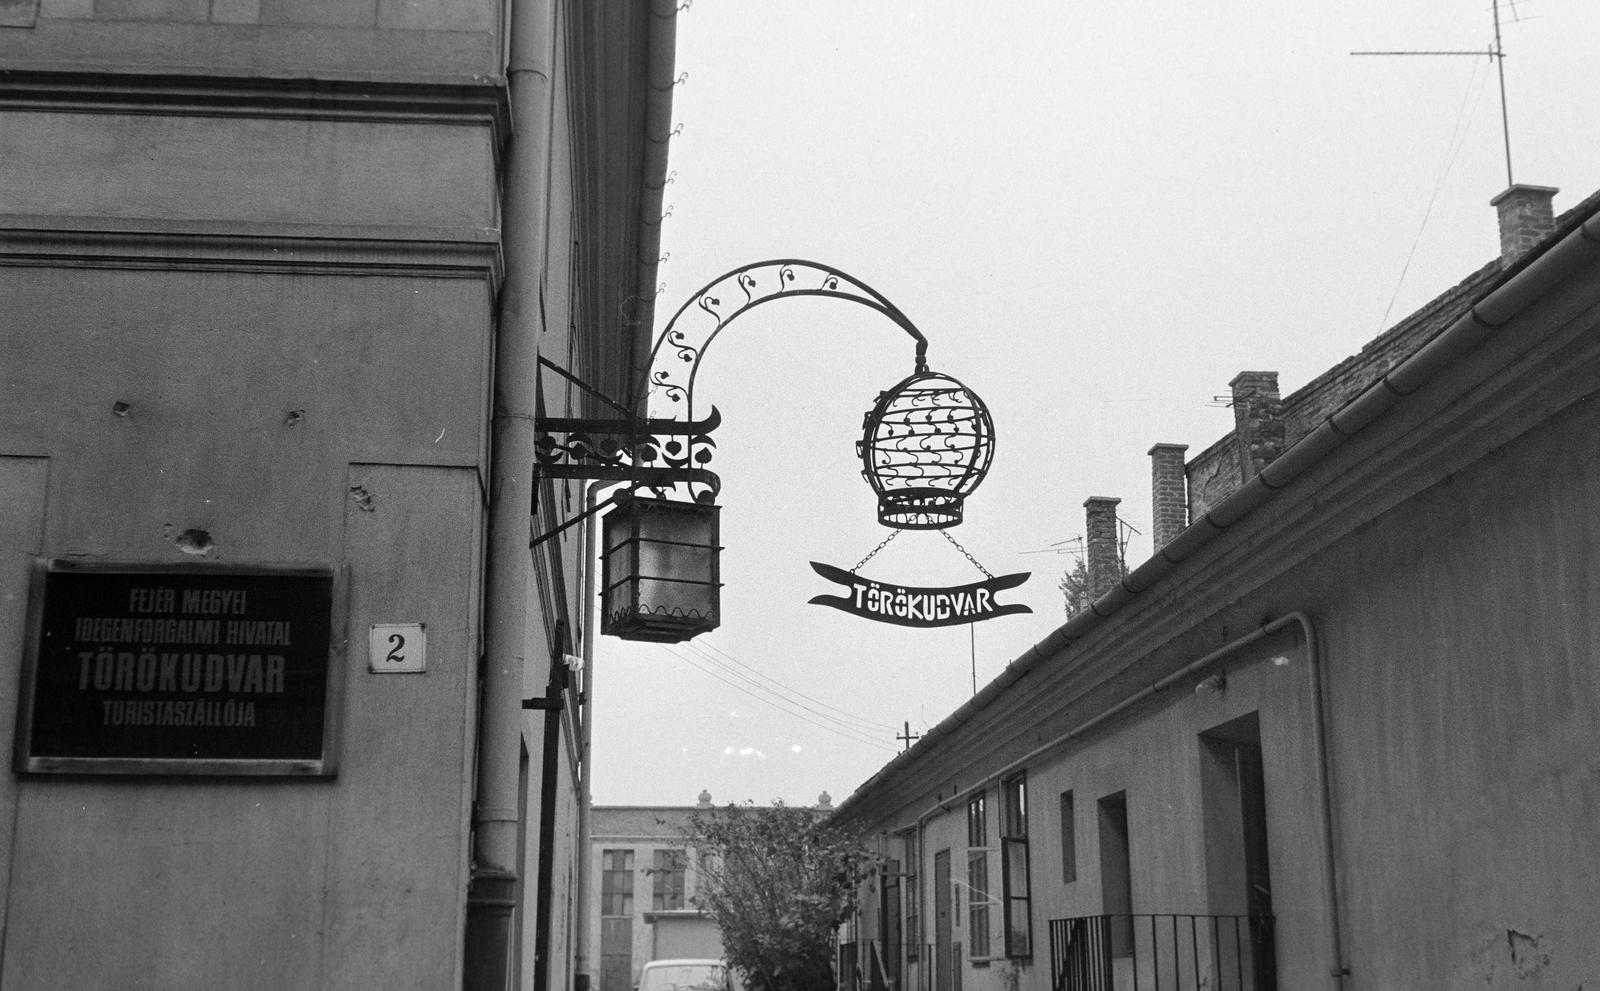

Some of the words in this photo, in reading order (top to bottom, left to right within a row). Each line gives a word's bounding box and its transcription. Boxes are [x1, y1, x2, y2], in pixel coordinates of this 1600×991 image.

[129, 587, 175, 614] FEJÉR
[182, 589, 247, 615] MEGYEI
[853, 582, 993, 621] TÖRÖKUDVAR
[75, 617, 221, 645] IDEGENFORGALMI
[227, 620, 291, 646] HIVATAL
[385, 633, 406, 663] 2
[78, 646, 285, 693] TÖRÖKUDVAR
[102, 699, 256, 727] TURISTASZÁLLÓJA
